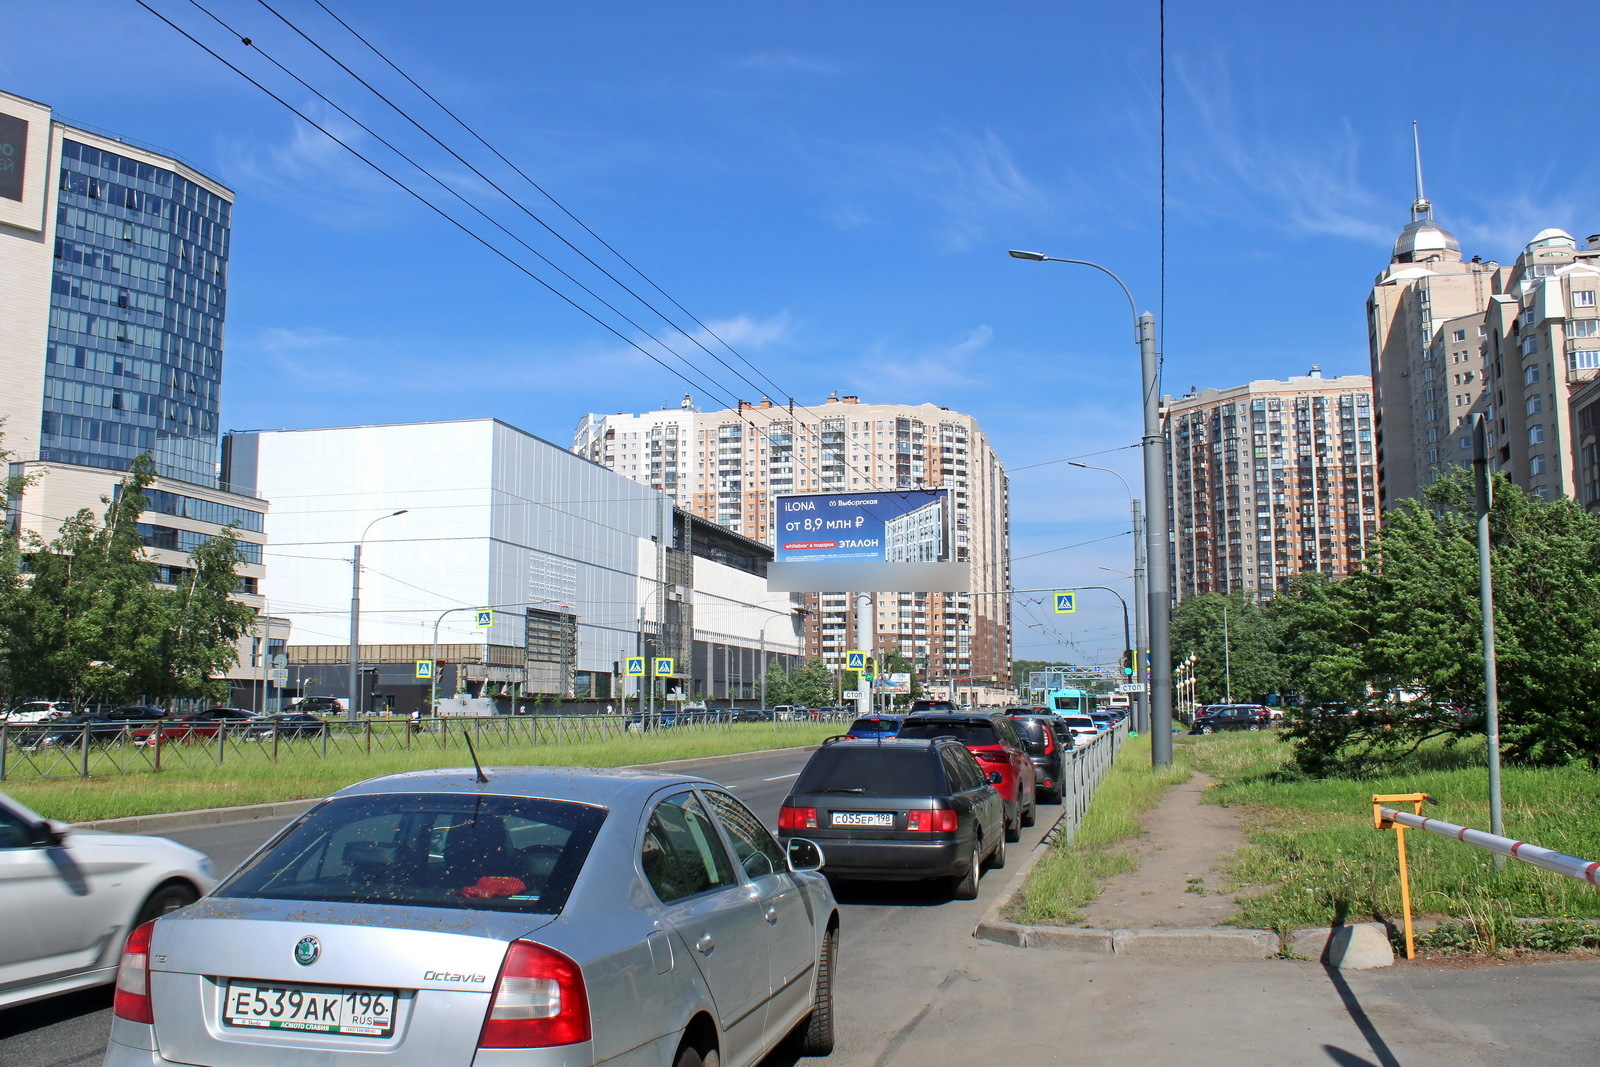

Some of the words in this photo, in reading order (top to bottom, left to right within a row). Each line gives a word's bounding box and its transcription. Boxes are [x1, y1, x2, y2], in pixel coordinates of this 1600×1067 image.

[785, 501, 816, 511] iLONA
[838, 499, 878, 507] Выборгская
[785, 522, 801, 531] от
[804, 518, 823, 532] 8,9
[838, 539, 879, 548] ЭТАЛОН
[1122, 684, 1142, 692] СТОП
[423, 970, 486, 984] Octavia
[346, 991, 386, 1016] 196
[352, 1015, 373, 1025] RUS
[280, 1021, 305, 1030] АСМОТО
